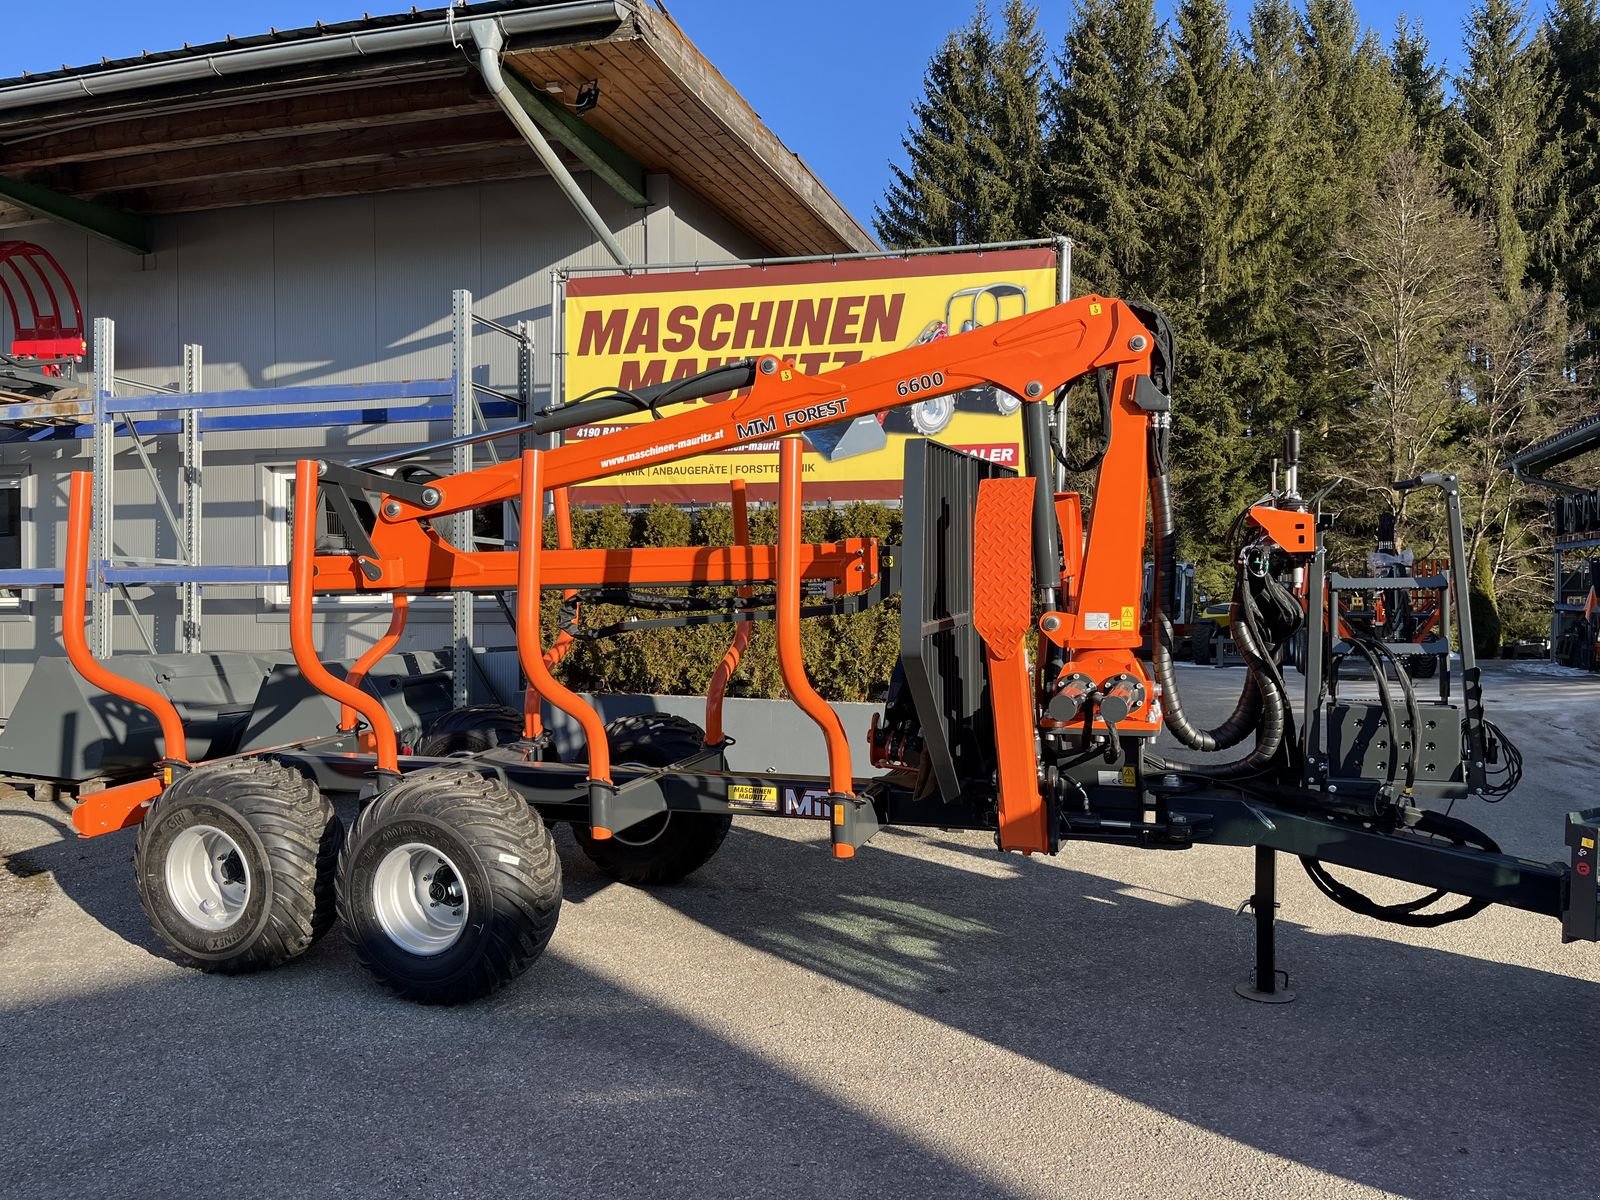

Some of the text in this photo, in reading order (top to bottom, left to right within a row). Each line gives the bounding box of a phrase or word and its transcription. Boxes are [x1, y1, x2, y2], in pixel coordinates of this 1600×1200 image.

[576, 293, 906, 357] MASCHINEN
[896, 371, 944, 396] 6600
[736, 398, 849, 440] MTM FOREST
[576, 428, 601, 437] 4190
[600, 428, 724, 468] www.maschinen-mauritz.at
[652, 464, 728, 476] ANBAUGERÄTE
[733, 786, 772, 795] MASCHINEN
[738, 793, 768, 801] MAURITZ
